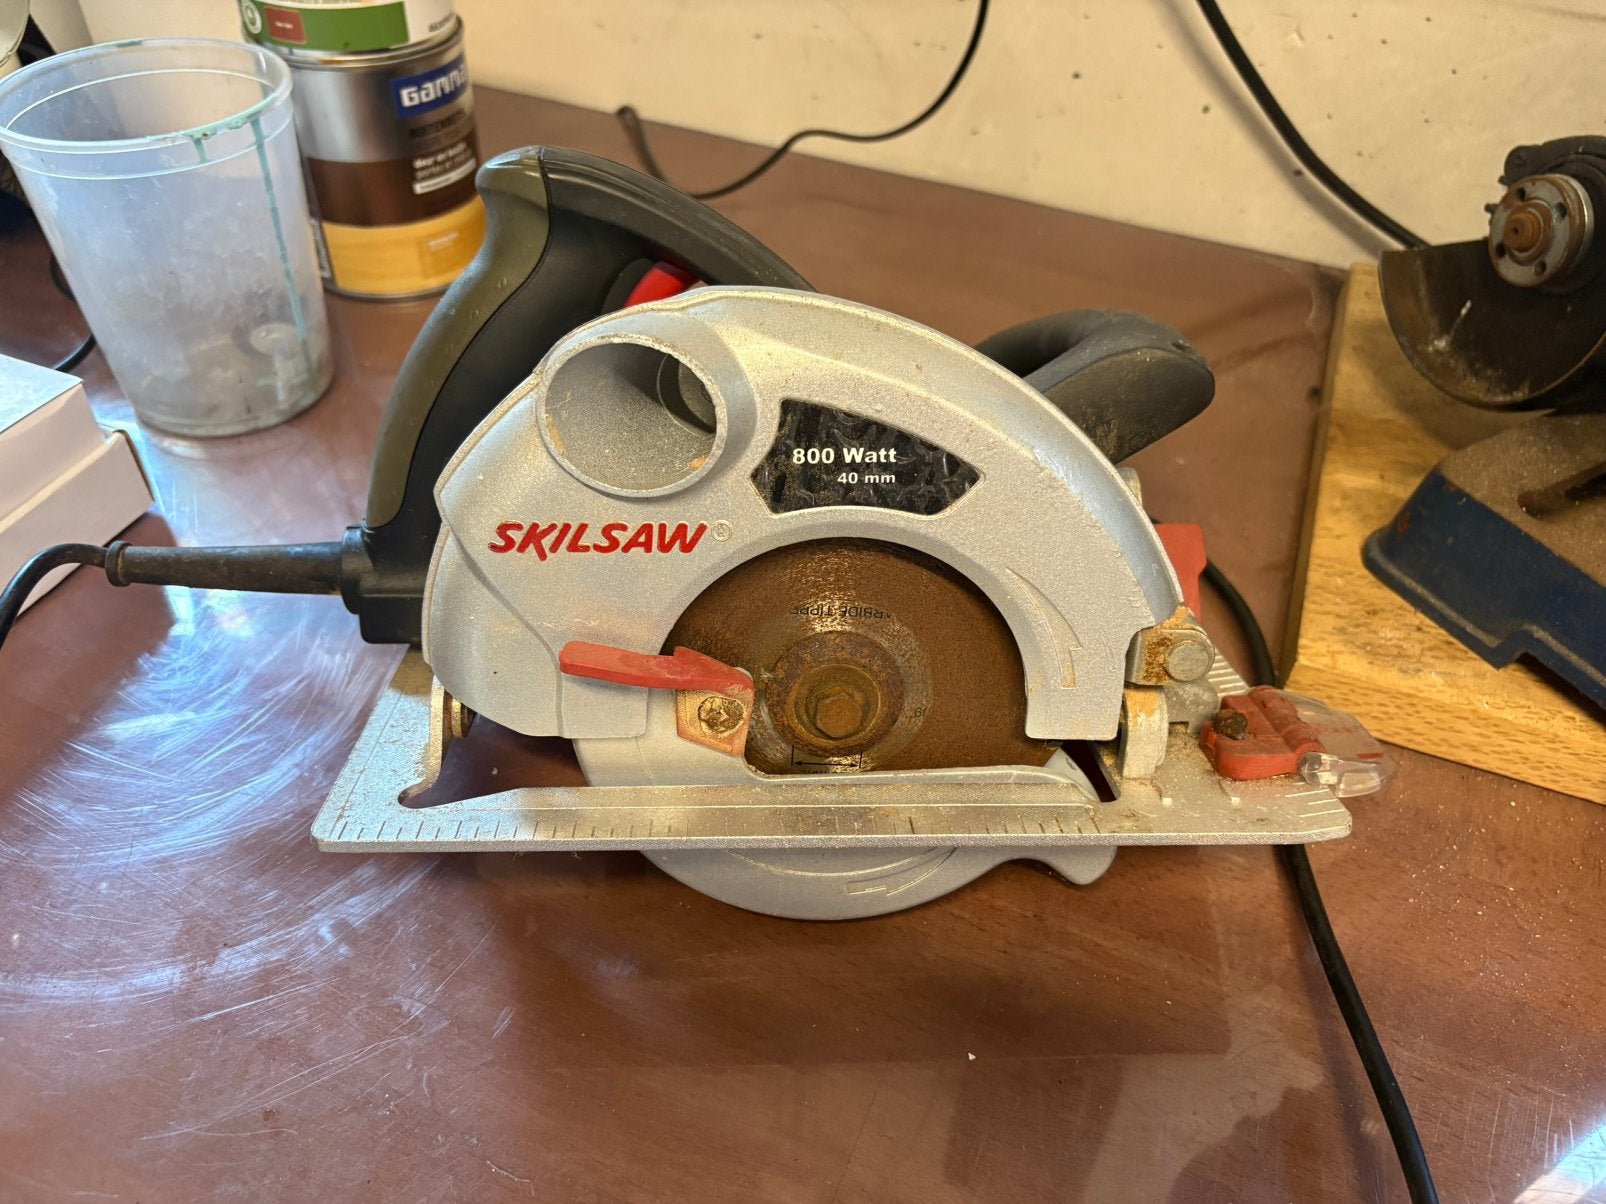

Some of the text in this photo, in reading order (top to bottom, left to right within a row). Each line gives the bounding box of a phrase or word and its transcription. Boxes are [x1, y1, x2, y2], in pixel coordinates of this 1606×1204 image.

[792, 447, 897, 464] 800 Watt
[837, 472, 896, 484] 40 mm
[488, 521, 708, 561] SKILSAW
